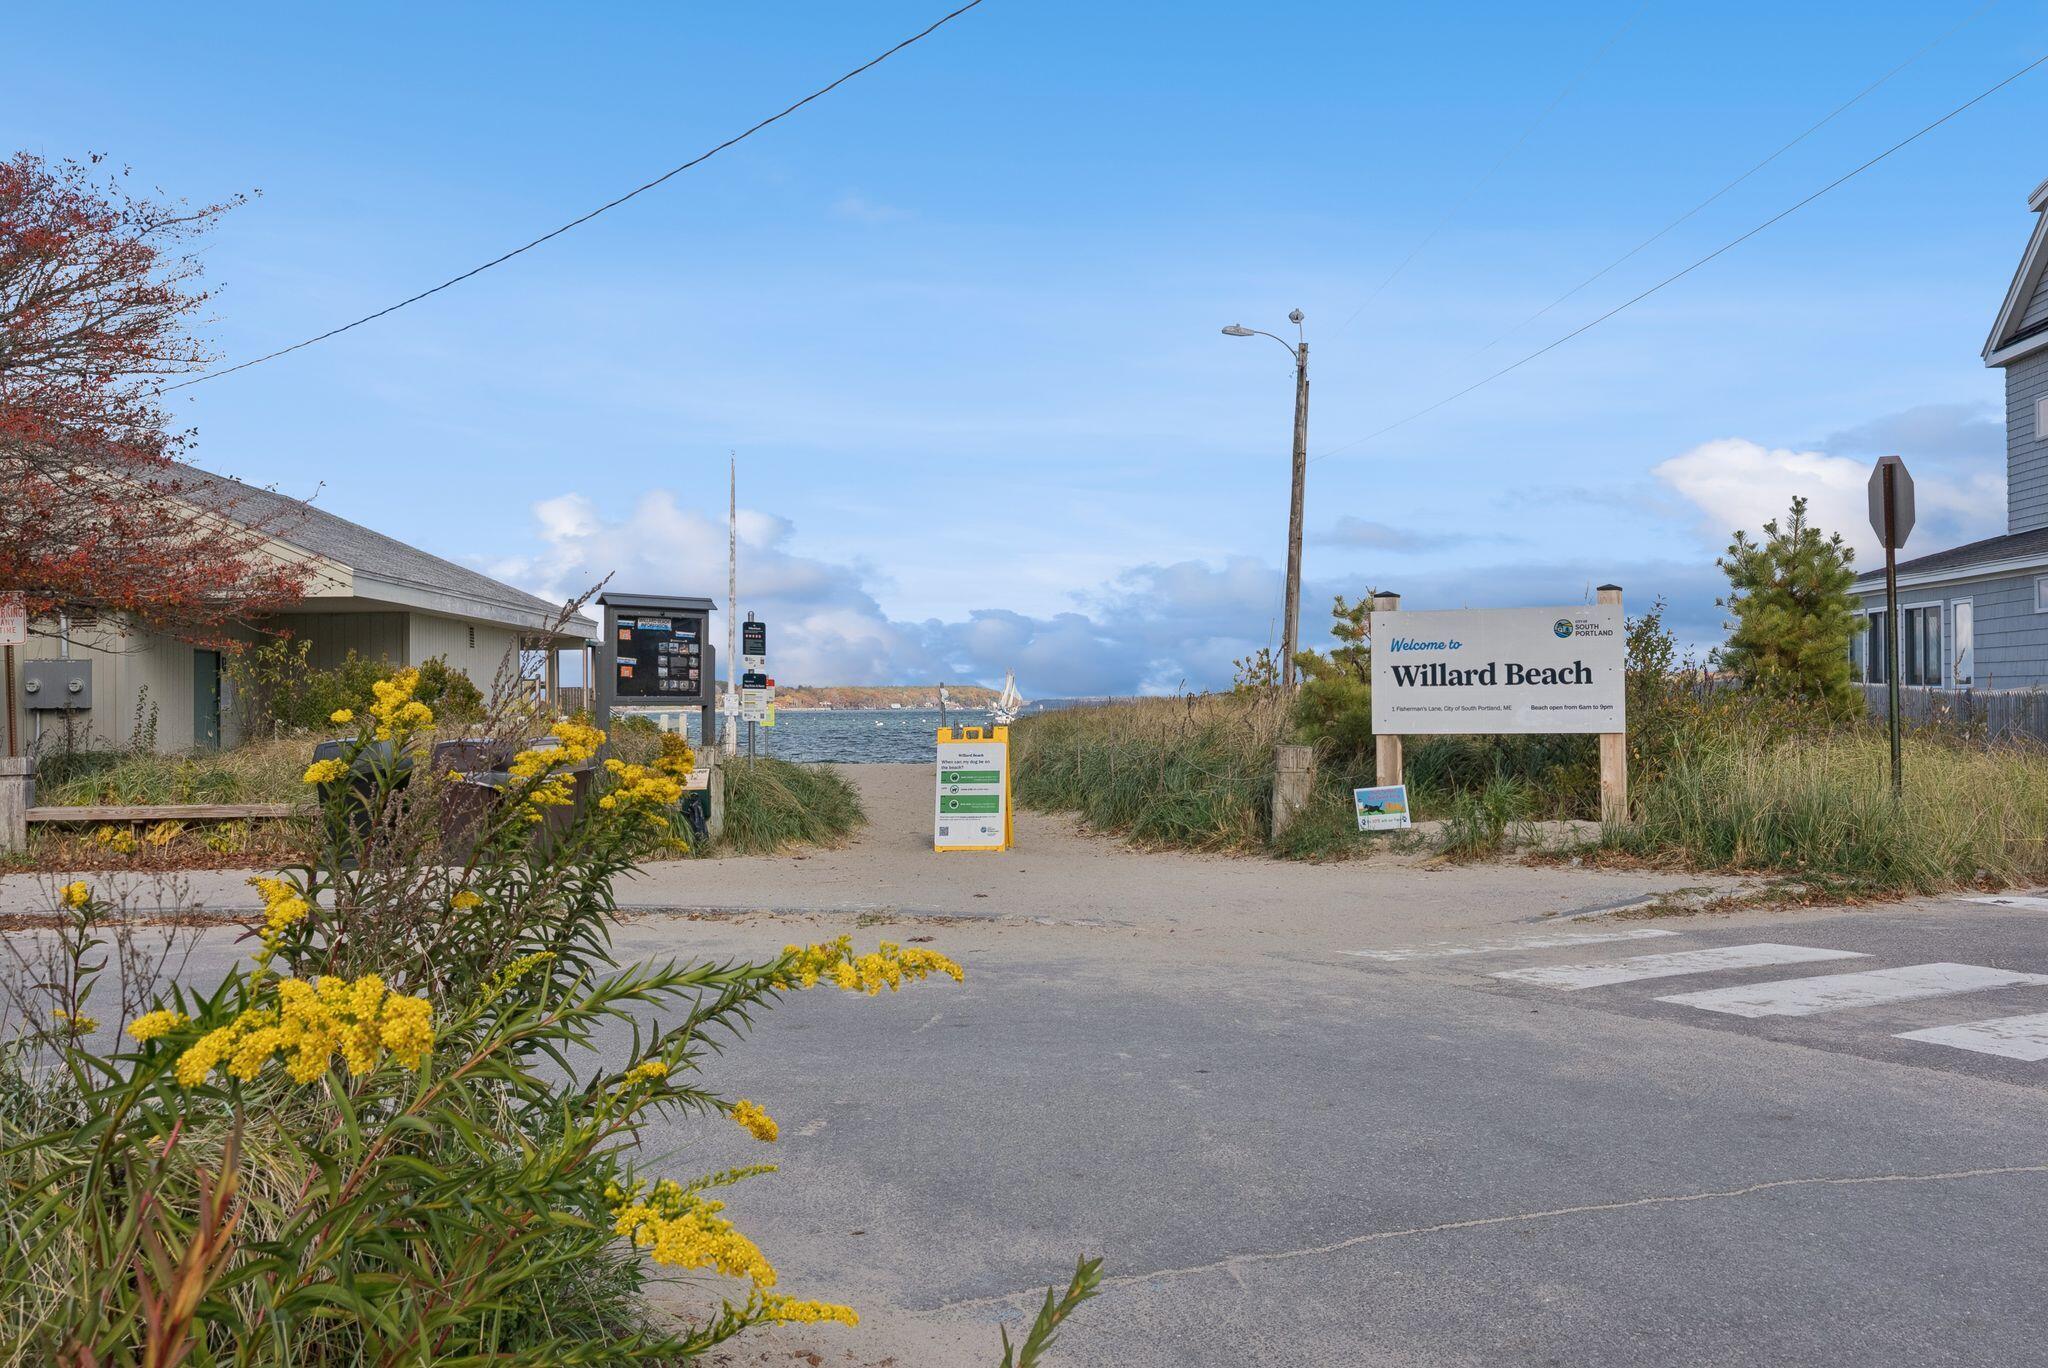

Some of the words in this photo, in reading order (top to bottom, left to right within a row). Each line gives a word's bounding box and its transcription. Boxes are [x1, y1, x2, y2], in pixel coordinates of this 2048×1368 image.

[0, 608, 22, 618] RKING
[1390, 638, 1447, 652] Welcome
[1448, 639, 1462, 650] to
[1391, 662, 1497, 687] Willard
[1504, 661, 1593, 685] Beach
